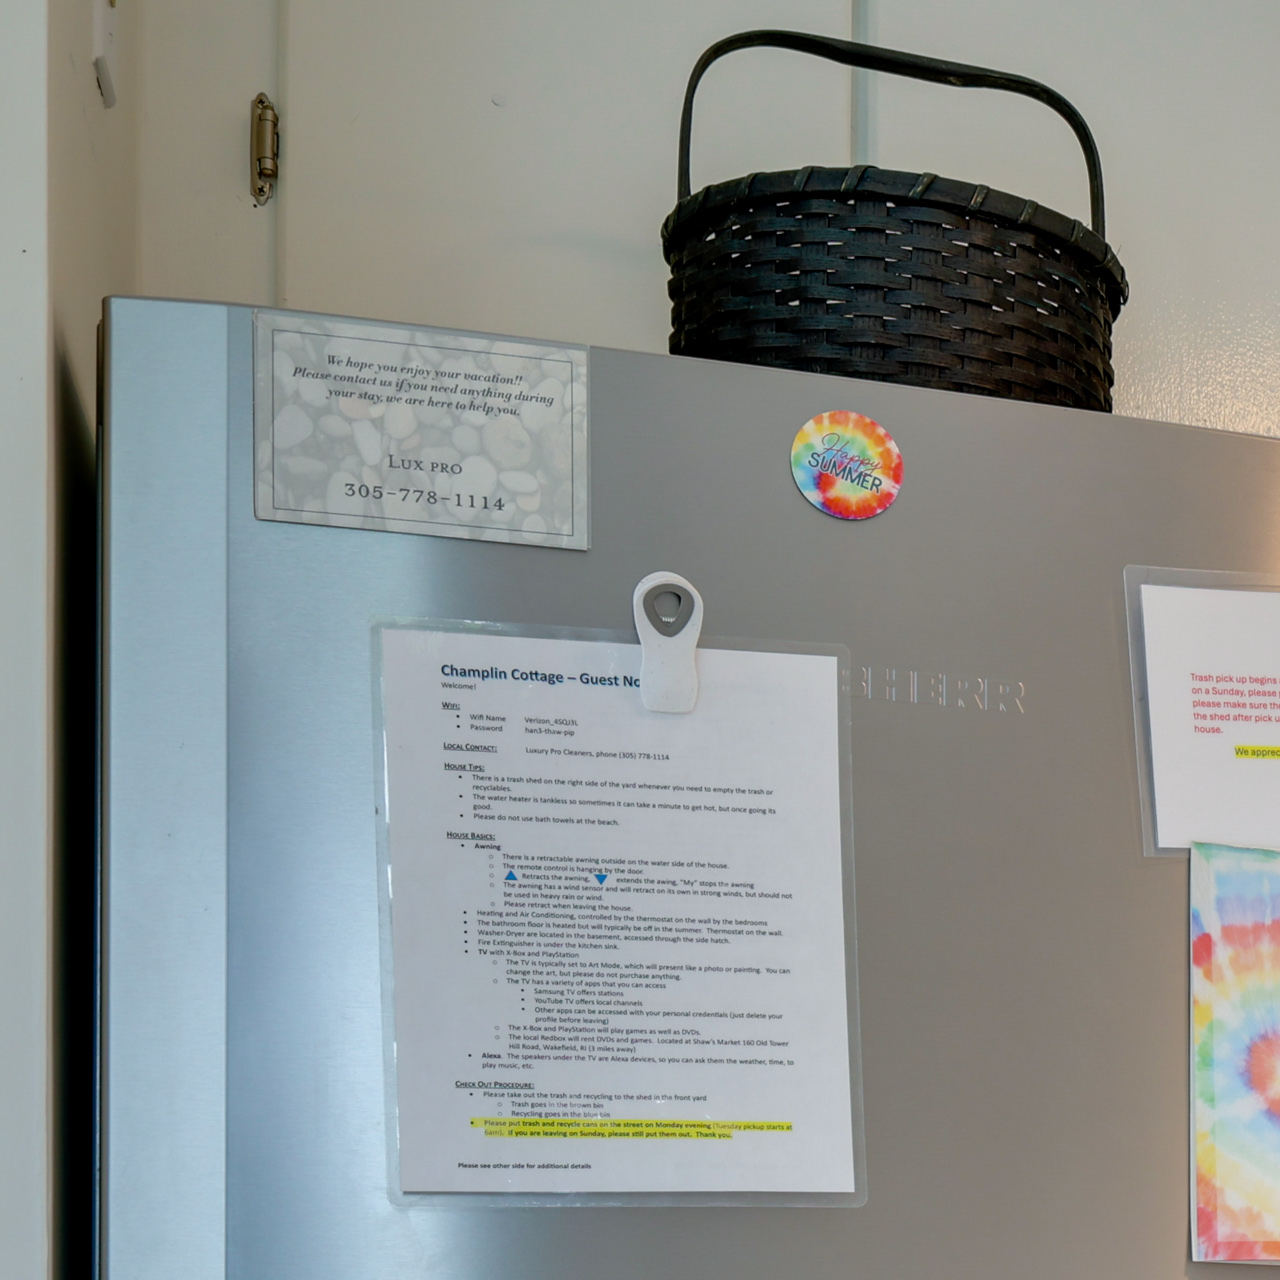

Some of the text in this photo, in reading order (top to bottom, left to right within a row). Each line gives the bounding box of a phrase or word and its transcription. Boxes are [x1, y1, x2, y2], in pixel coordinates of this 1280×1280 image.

[328, 355, 523, 386] We hope you enjoy your vacation!!
[292, 366, 332, 380] Please
[333, 375, 377, 385] contact
[396, 379, 405, 393] if
[405, 379, 428, 393] you
[431, 384, 458, 394] need
[460, 387, 512, 403] anything
[514, 391, 554, 408] during
[326, 389, 520, 417] your stay, we are here to help you.
[822, 433, 883, 477] Happy
[808, 452, 882, 494] SUMMER
[344, 483, 506, 512] 305-778-1114
[441, 664, 507, 681] Champlin
[511, 669, 564, 685] Cottage
[580, 673, 620, 686] Guest
[1190, 673, 1214, 682] Trash
[1216, 675, 1234, 684] pick
[1236, 677, 1247, 685] up
[1249, 676, 1277, 686] begins
[441, 682, 476, 690] Welcome!
[1212, 687, 1246, 698] Sunday,
[1248, 689, 1277, 698] please
[1193, 699, 1222, 708] please
[1224, 701, 1247, 709] make
[1193, 712, 1208, 721] the
[1209, 713, 1230, 721] shed
[1233, 714, 1253, 722] after
[1254, 714, 1273, 723] pick
[1194, 725, 1223, 734] house.
[526, 747, 549, 756] Luxury
[563, 749, 594, 757] Cleaners,
[619, 752, 637, 760] (305)
[1234, 748, 1249, 756] We
[475, 843, 501, 851] Awning
